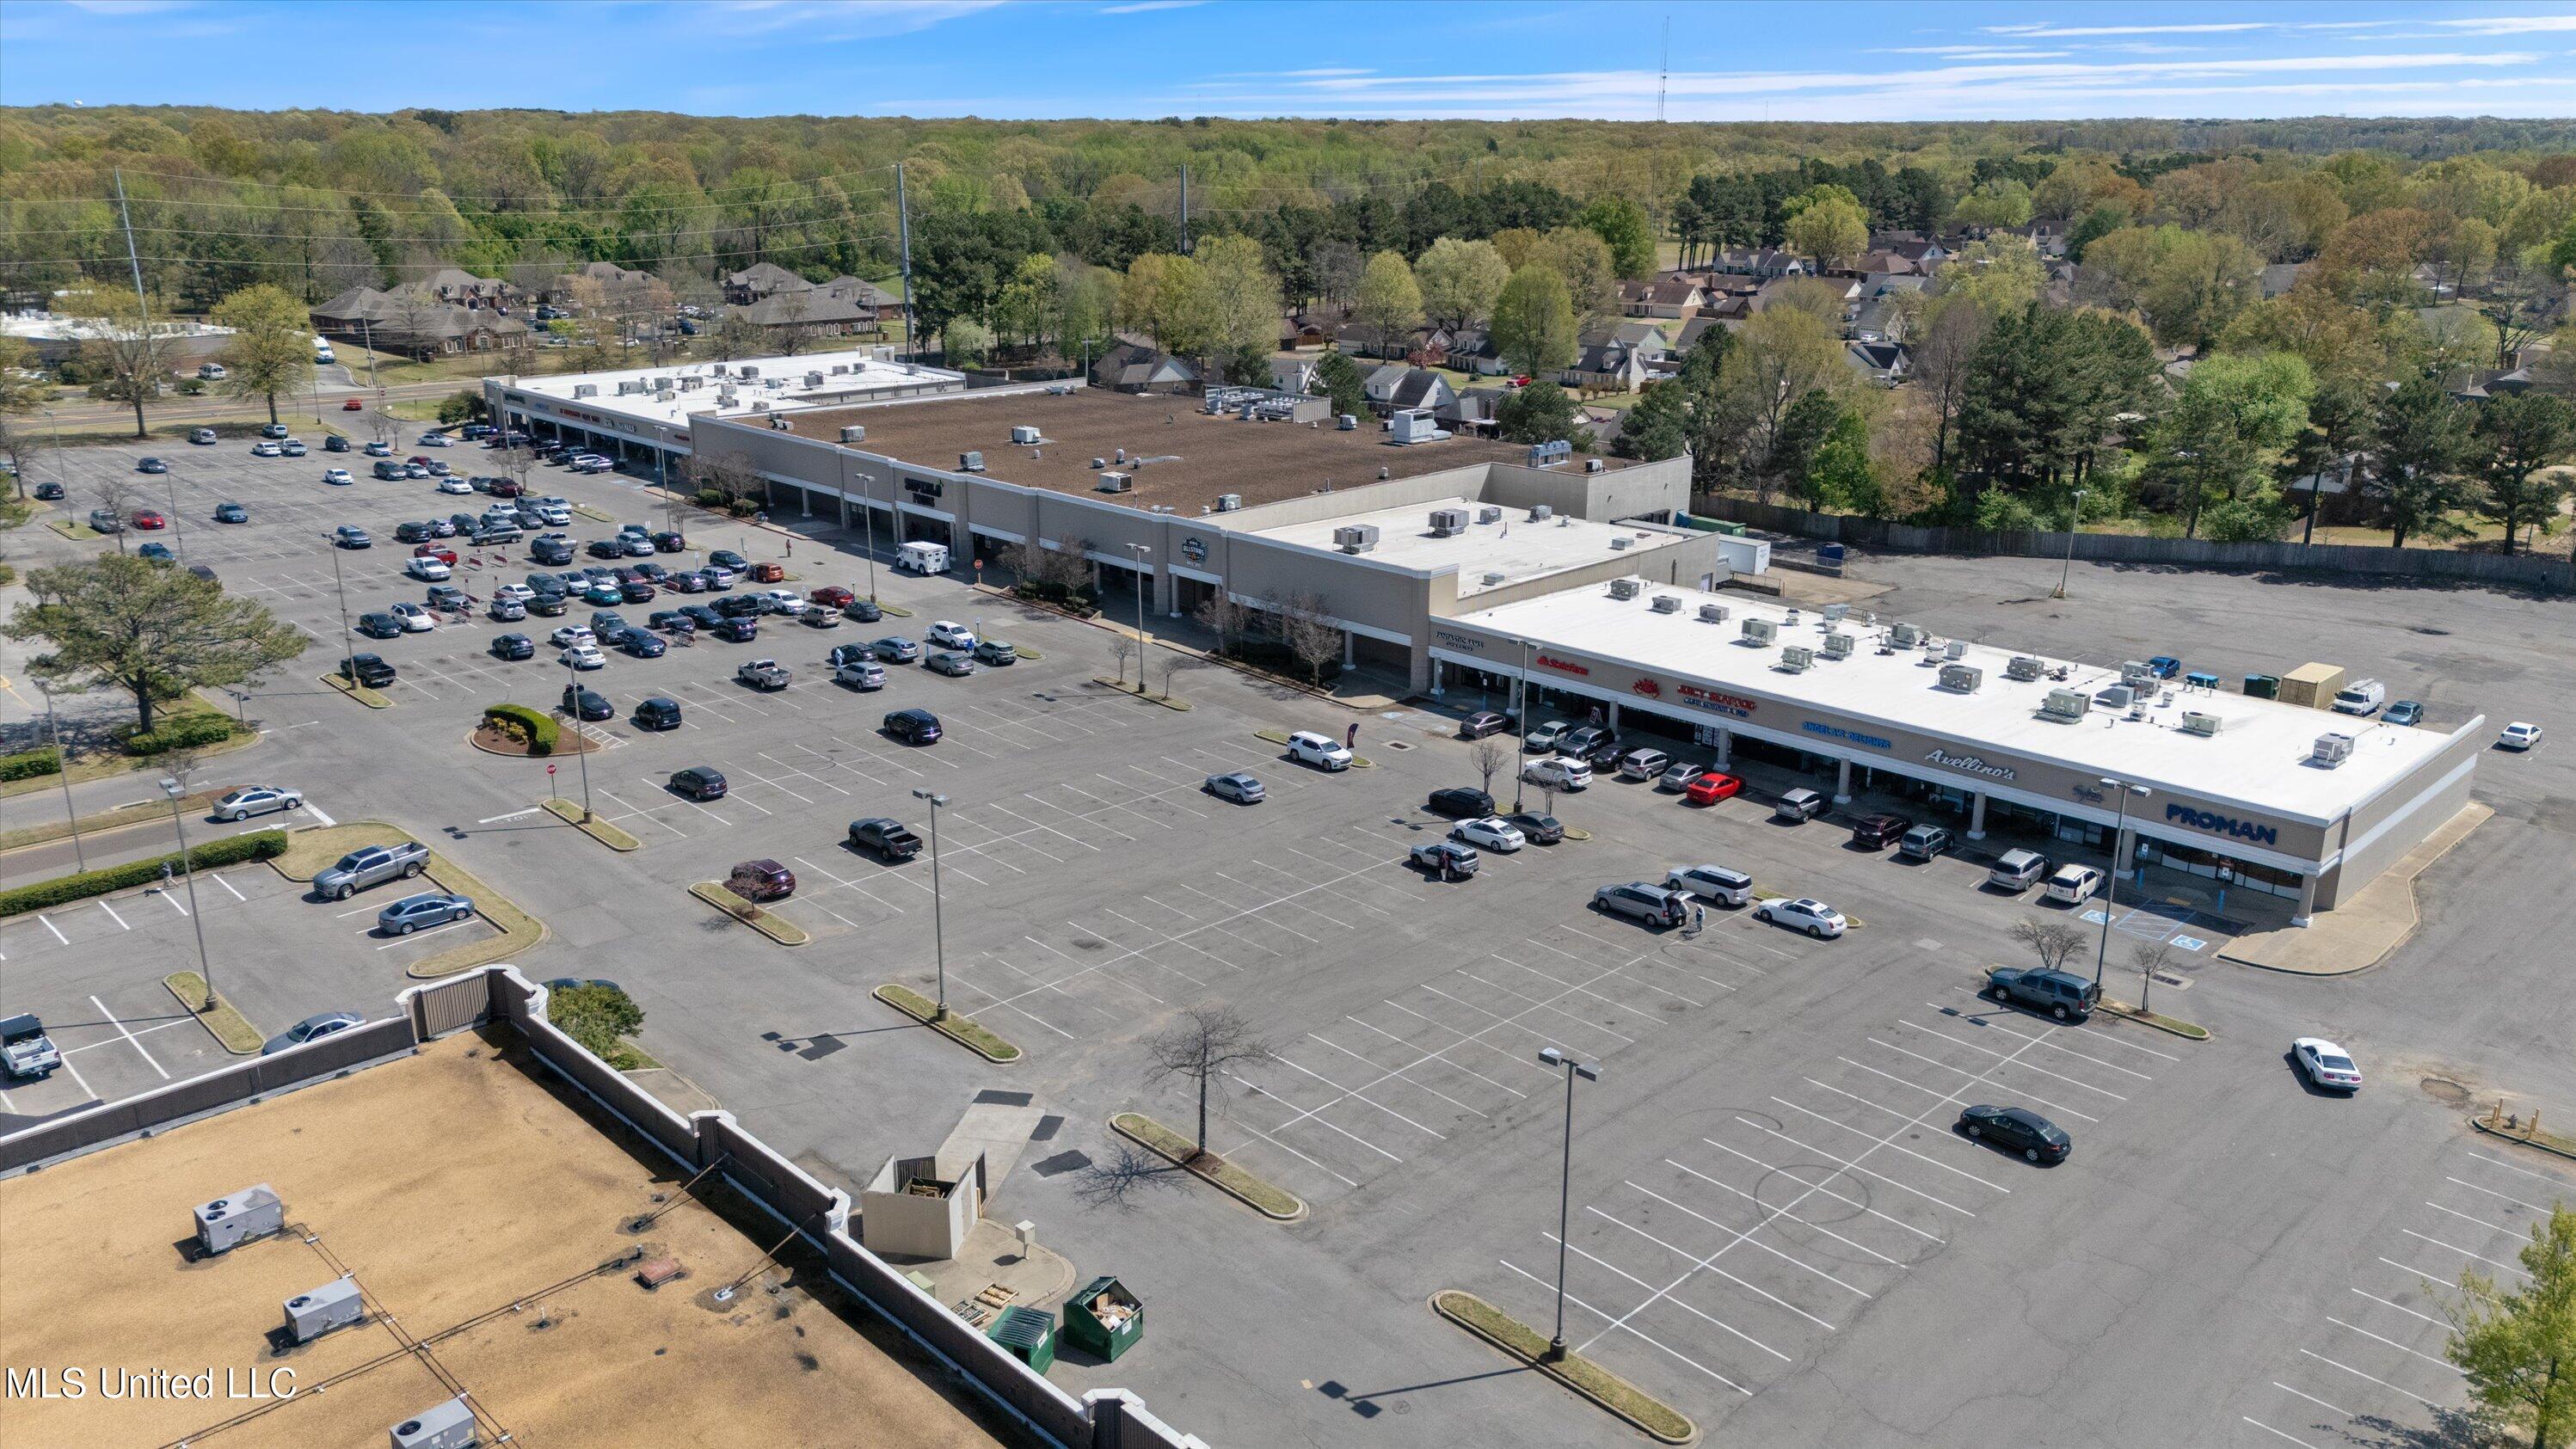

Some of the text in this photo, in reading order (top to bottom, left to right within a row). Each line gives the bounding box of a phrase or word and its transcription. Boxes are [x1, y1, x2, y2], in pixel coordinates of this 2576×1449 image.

[1708, 691, 1756, 711] SEAFOOD
[1847, 731, 1891, 750] DELIGHTS
[1925, 748, 2014, 781] Avellino's
[2166, 803, 2277, 845] PROMAN
